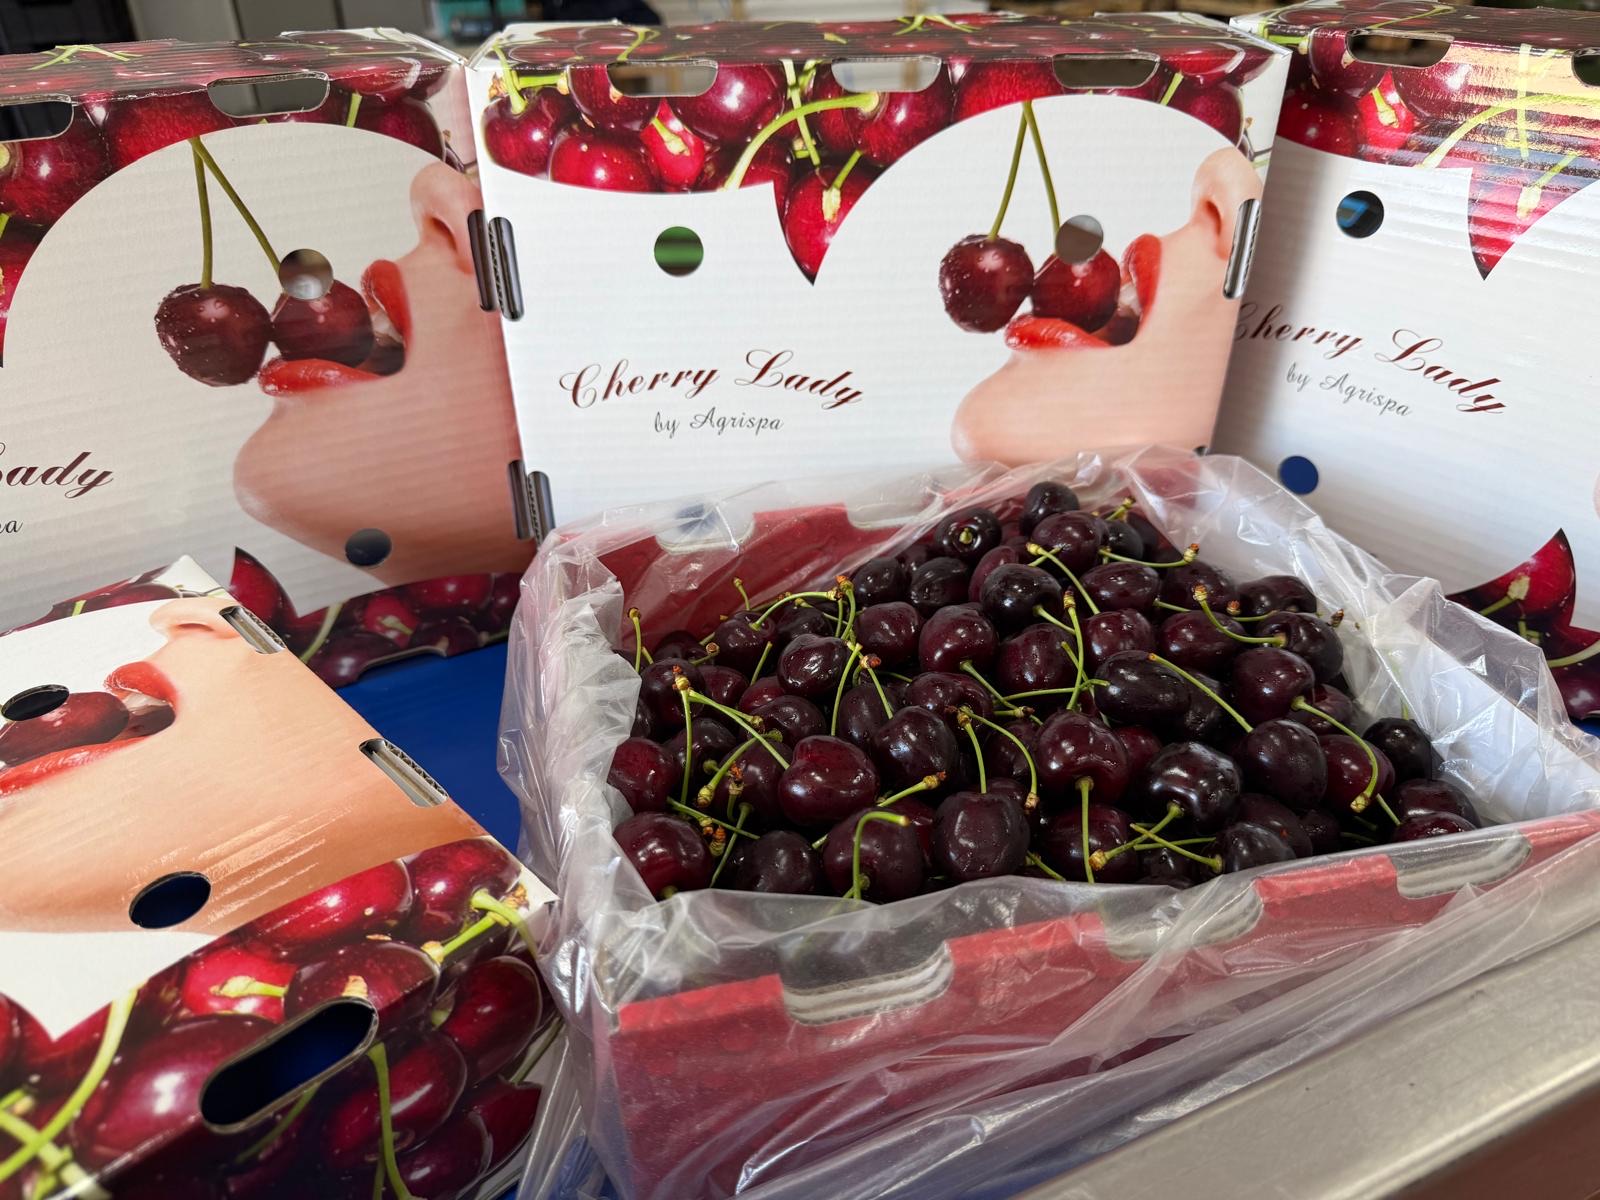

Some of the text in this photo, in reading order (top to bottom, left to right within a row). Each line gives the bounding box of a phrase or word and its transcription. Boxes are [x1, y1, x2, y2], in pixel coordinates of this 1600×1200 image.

[559, 349, 866, 410] Cherry Lady
[1286, 362, 1412, 416] by Agrispa
[1374, 328, 1507, 414] Lady
[654, 407, 784, 438] by Agrispa
[0, 442, 114, 499] ady
